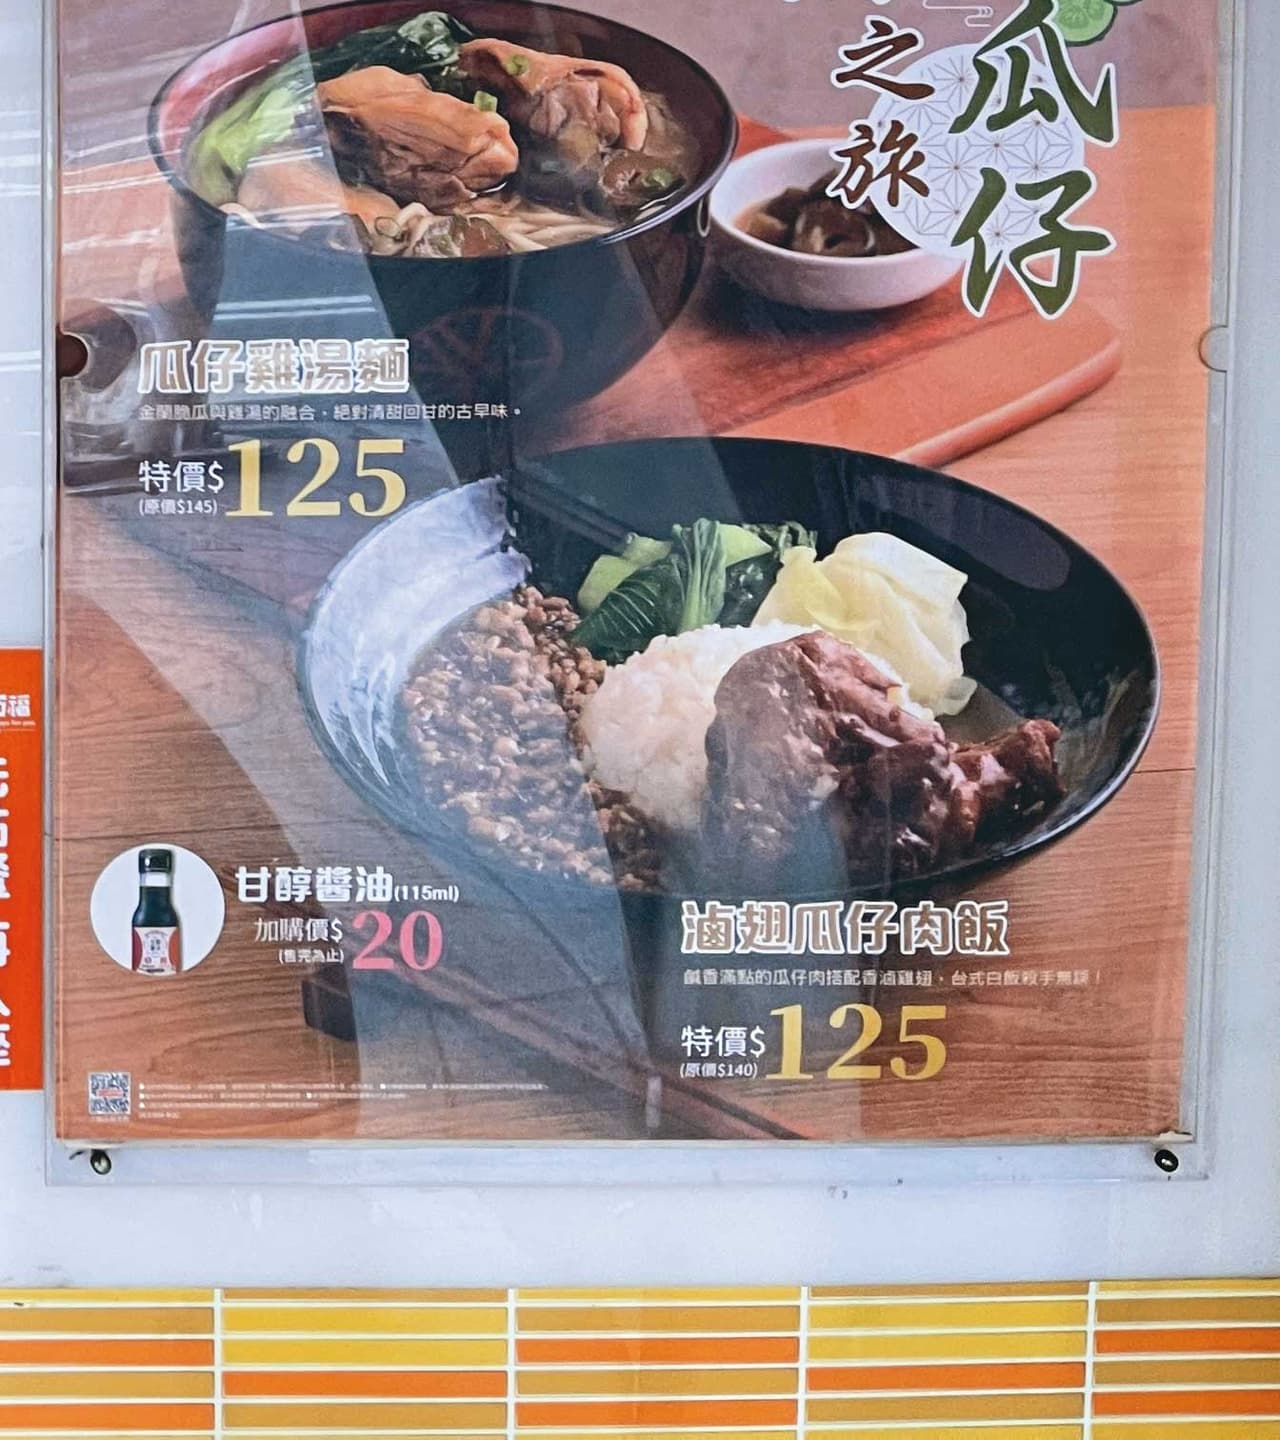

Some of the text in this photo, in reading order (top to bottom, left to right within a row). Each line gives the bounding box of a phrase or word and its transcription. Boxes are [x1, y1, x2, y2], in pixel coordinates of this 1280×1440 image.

[138, 338, 410, 394] 瓜仔雞湯麵
[225, 437, 407, 518] 125
[352, 910, 443, 971] 20
[681, 899, 1010, 956] 滷翅瓜仔肉飯
[764, 1003, 948, 1080] 125
